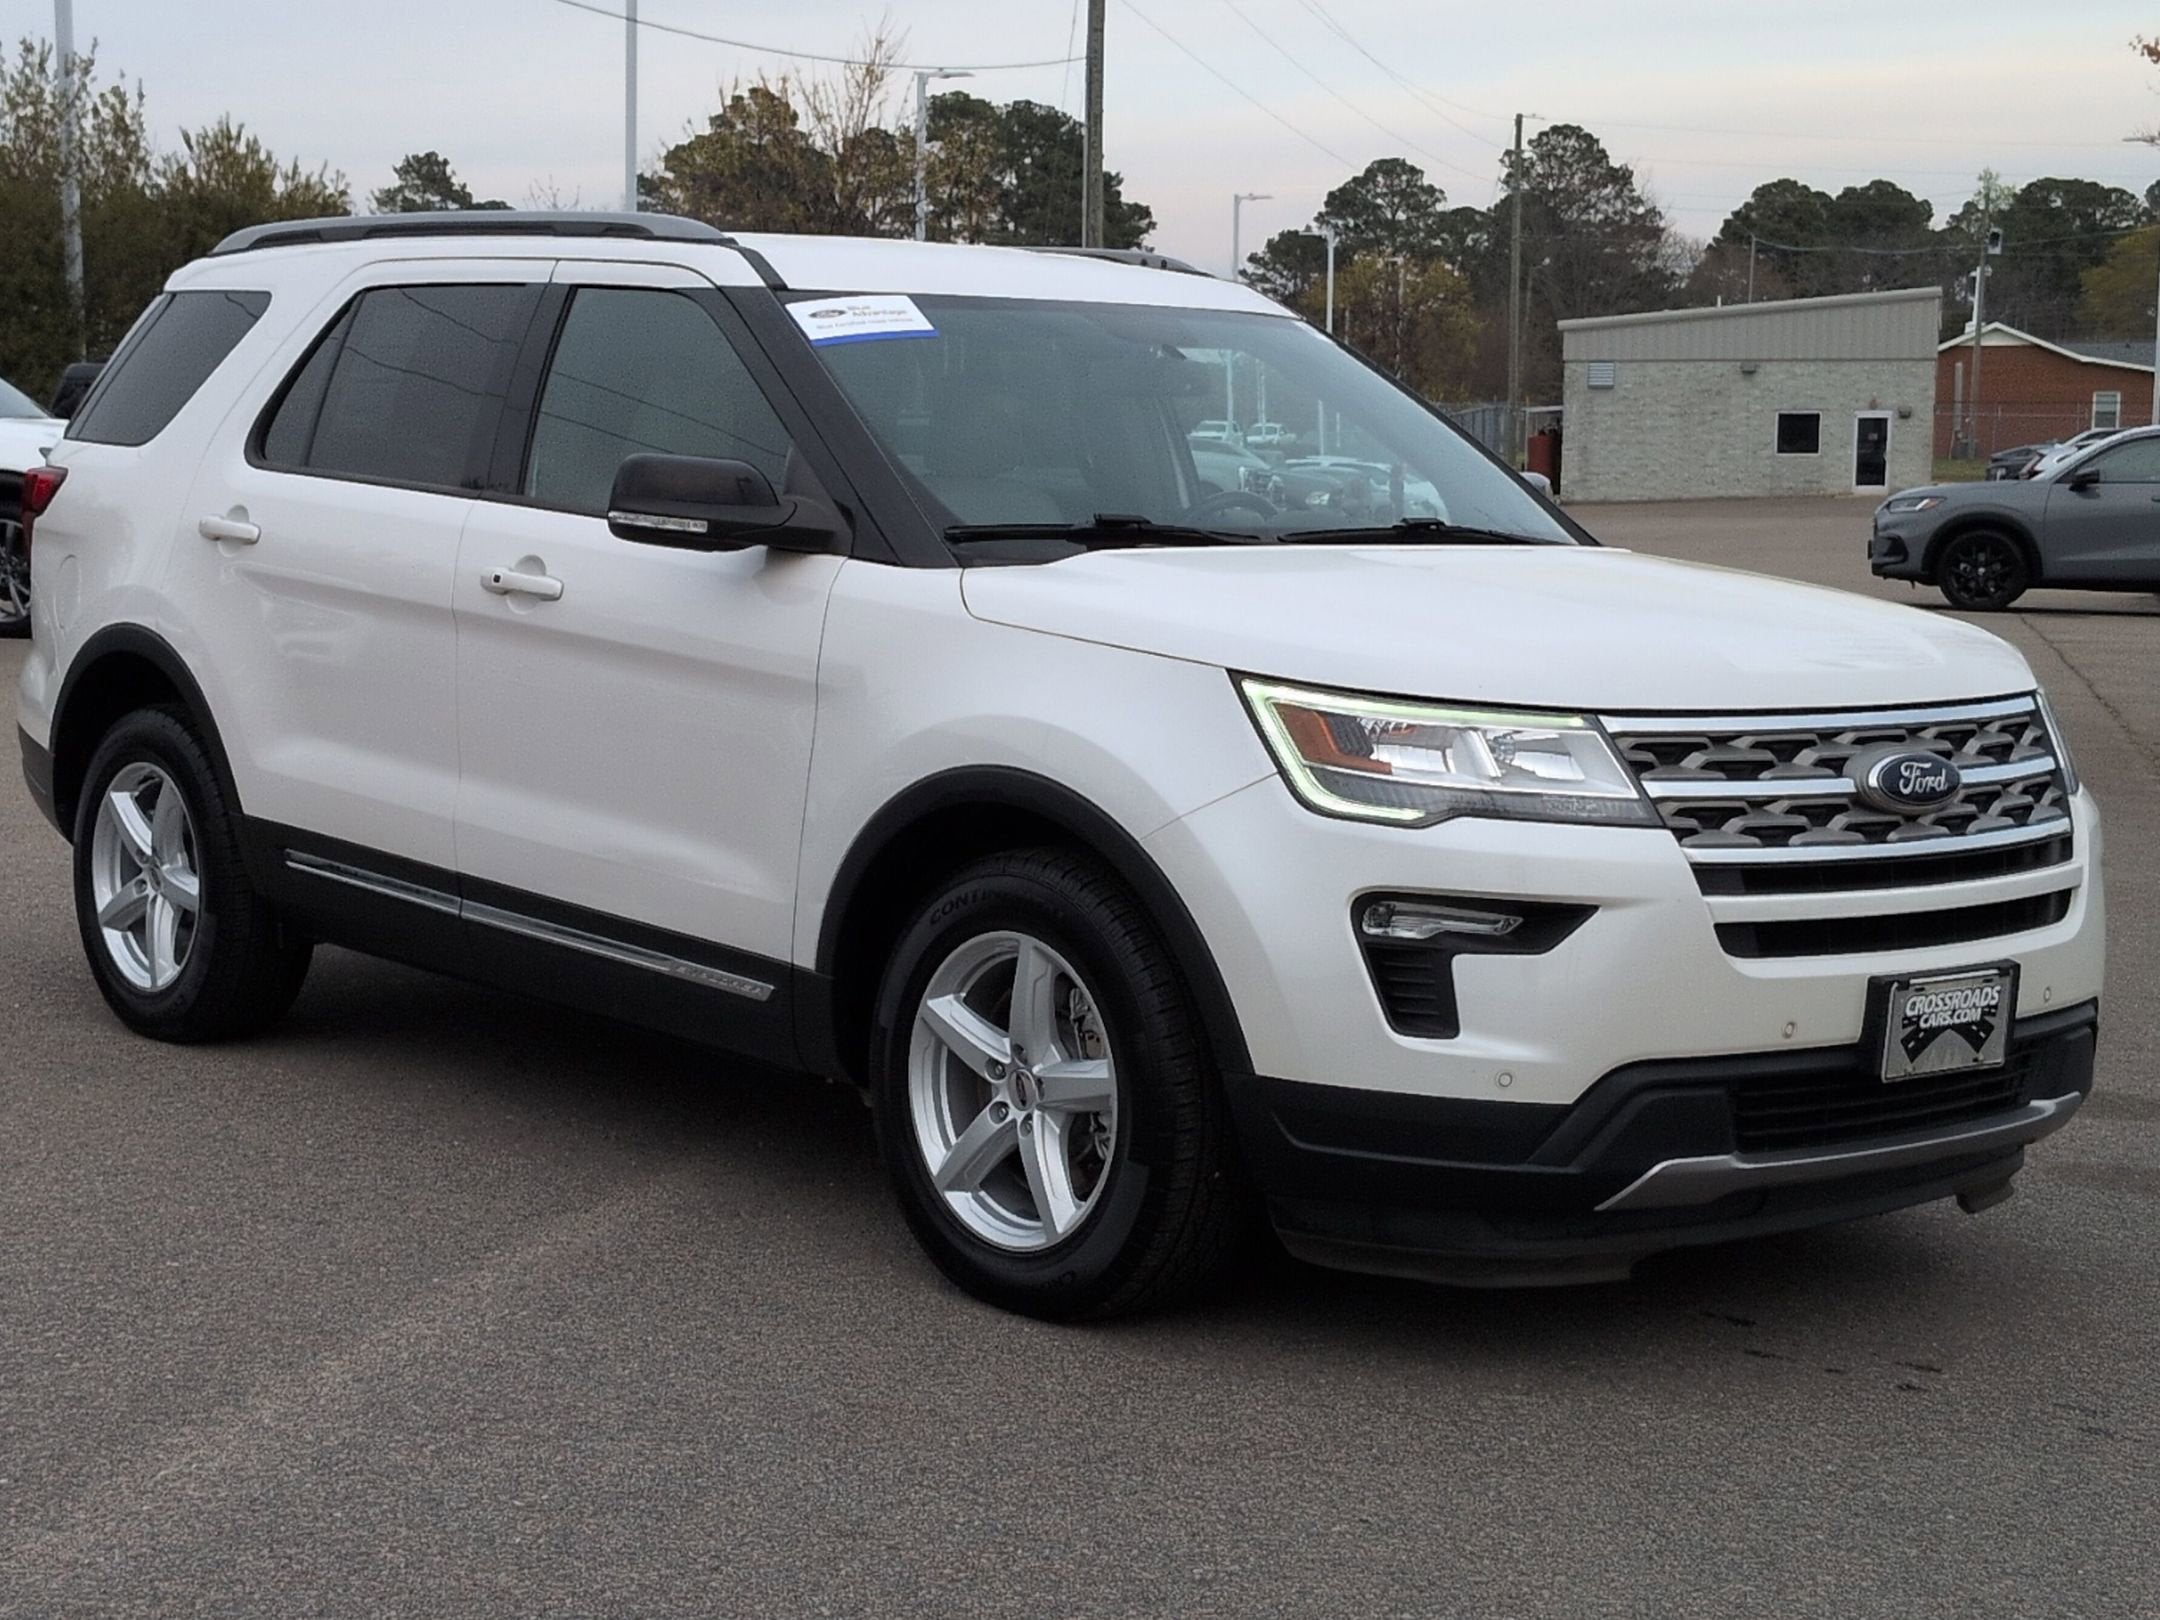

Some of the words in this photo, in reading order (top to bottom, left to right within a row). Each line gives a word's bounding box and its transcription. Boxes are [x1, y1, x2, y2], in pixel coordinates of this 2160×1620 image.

[1899, 761, 1948, 795] Ford
[1905, 986, 2001, 1016] CROSSROADS
[1919, 1007, 1981, 1028] CARS.COM
